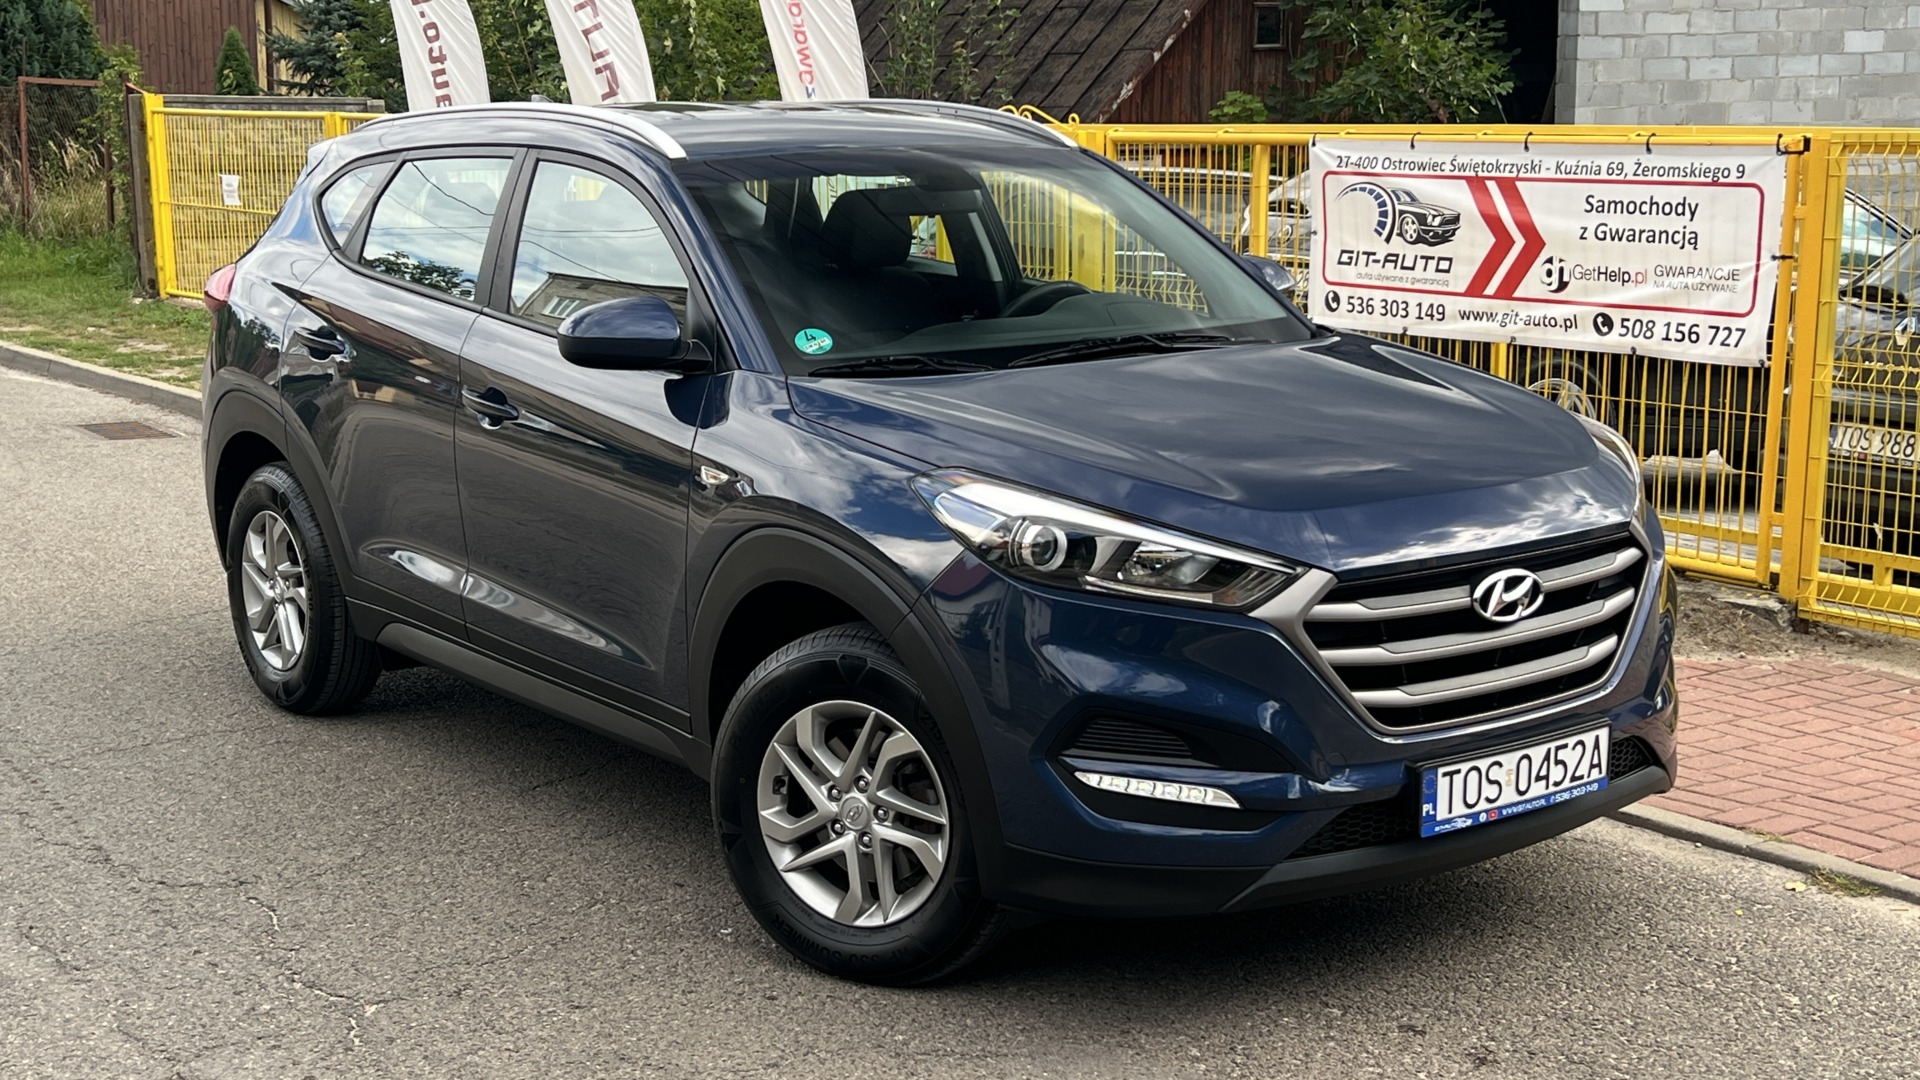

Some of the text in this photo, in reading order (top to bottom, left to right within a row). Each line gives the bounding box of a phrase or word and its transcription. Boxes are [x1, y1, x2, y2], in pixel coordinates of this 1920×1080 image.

[1336, 155, 1378, 170] 27-400
[1381, 156, 1446, 172] Ostrowiec
[1449, 154, 1542, 177] Świętokrzyski
[1555, 159, 1601, 176] Kuźnia
[1606, 161, 1628, 180] 69,
[1632, 158, 1731, 182] Żeromskiego
[1736, 163, 1746, 179] 9
[1584, 194, 1699, 222] Samochody
[1579, 222, 1699, 250] z Gwarancją
[1337, 249, 1454, 274] GIT-AUTO
[1653, 264, 1741, 282] GWARANCJE
[1572, 263, 1648, 287] GetHelp.pl
[1666, 281, 1690, 291] AUTA
[1346, 295, 1446, 322] 536 303 149
[1458, 308, 1579, 332] www.git-auto.pl
[803, 330, 817, 341] 4
[1618, 317, 1747, 348] 508 156 727
[1441, 734, 1603, 815] TOS 0452A
[1422, 802, 1436, 817] PL
